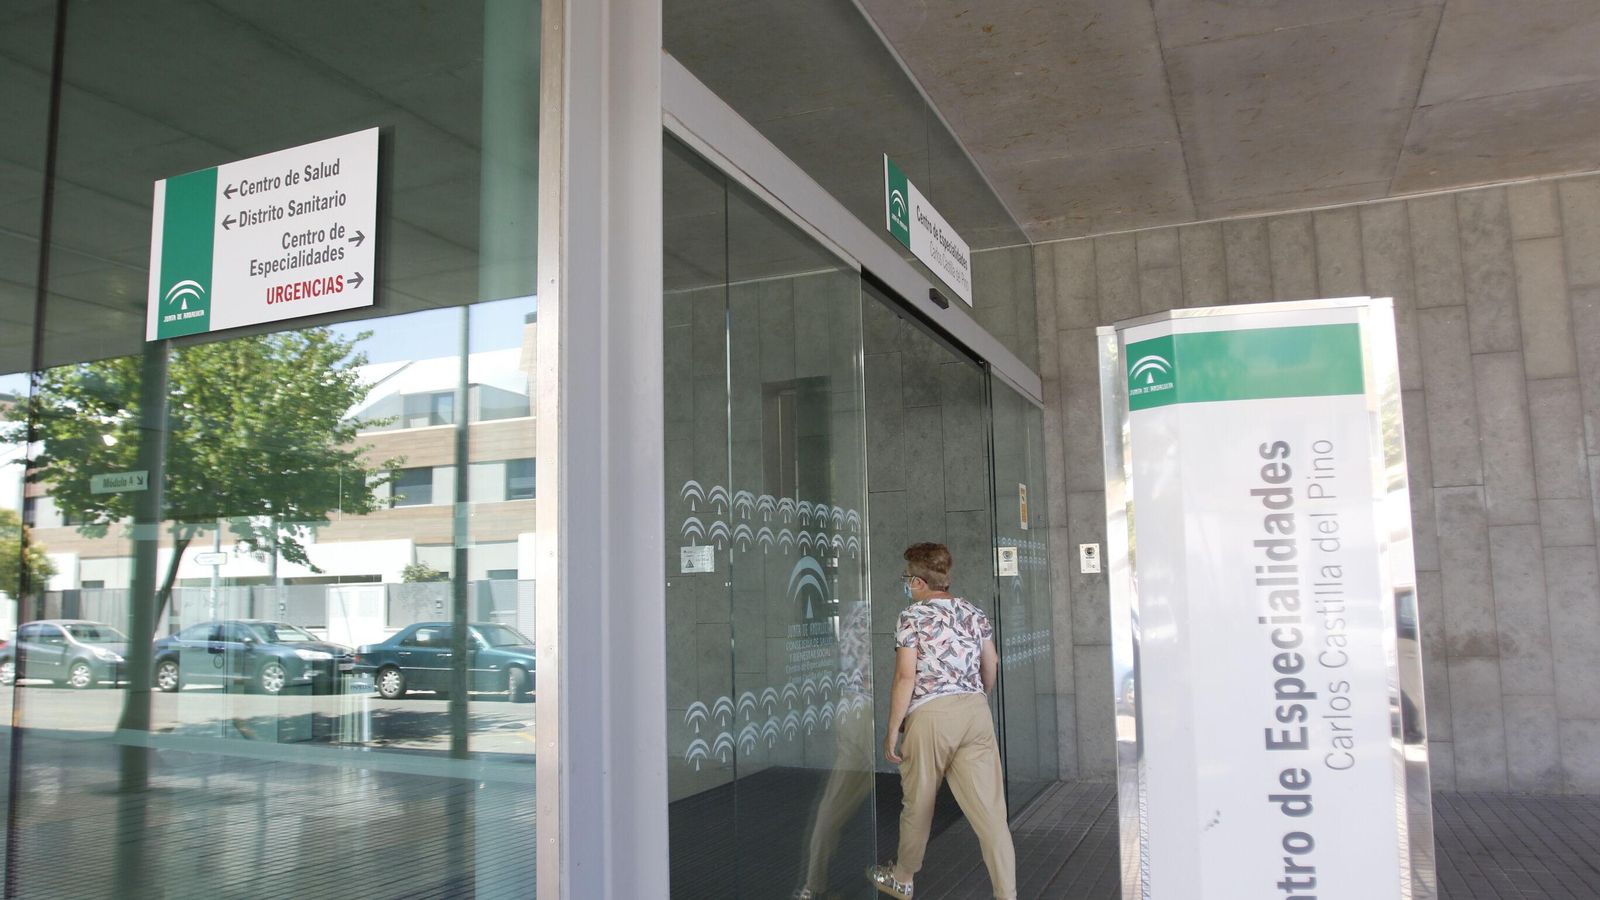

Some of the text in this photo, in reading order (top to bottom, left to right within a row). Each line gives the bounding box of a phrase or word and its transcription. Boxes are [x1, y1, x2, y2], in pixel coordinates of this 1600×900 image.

[240, 158, 340, 197] Centro de Salud
[239, 190, 346, 228] Distrito Sanitario
[282, 222, 345, 250] Centro de
[917, 204, 968, 271] Centro de Especialidades
[250, 244, 345, 278] Especialidades
[266, 274, 344, 305] URGENCIAS
[1306, 439, 1355, 770] Carlos Castilla del Pino
[1250, 440, 1318, 900] tro de Especialidades
